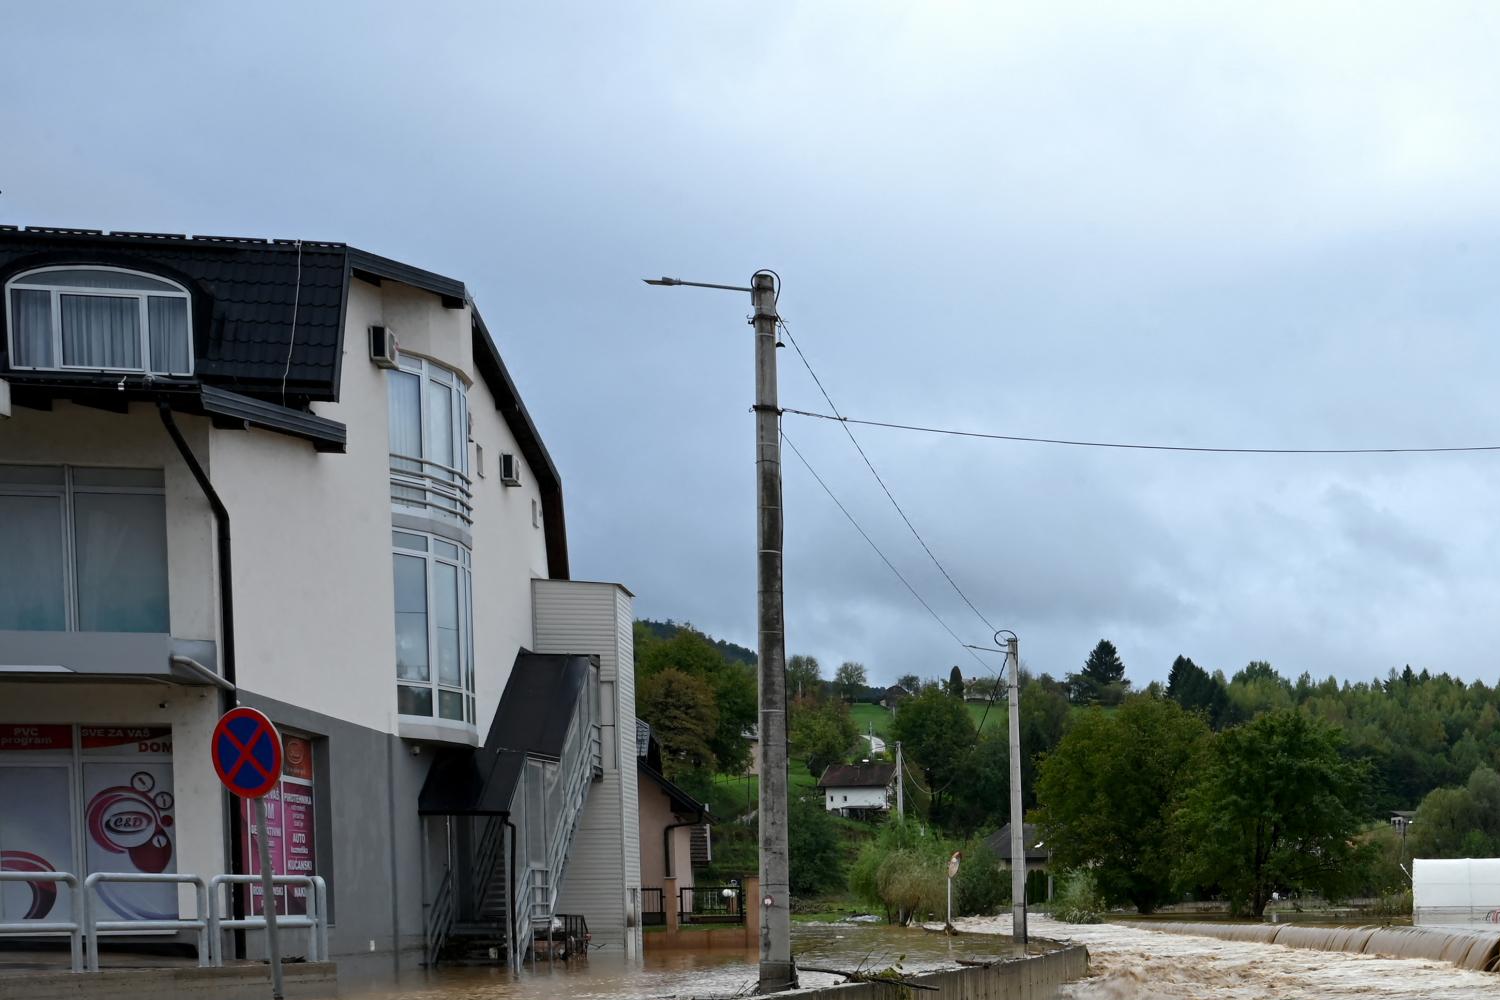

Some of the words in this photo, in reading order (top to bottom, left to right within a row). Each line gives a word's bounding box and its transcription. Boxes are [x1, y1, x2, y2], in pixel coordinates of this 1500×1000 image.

[14, 728, 39, 736] PVC
[80, 728, 106, 737] SVE
[108, 728, 127, 737] ZA
[129, 727, 152, 737] VAŠ
[1, 736, 53, 746] program
[138, 742, 172, 752] DOM
[113, 816, 143, 828] C&D
[292, 833, 306, 844] AUTO
